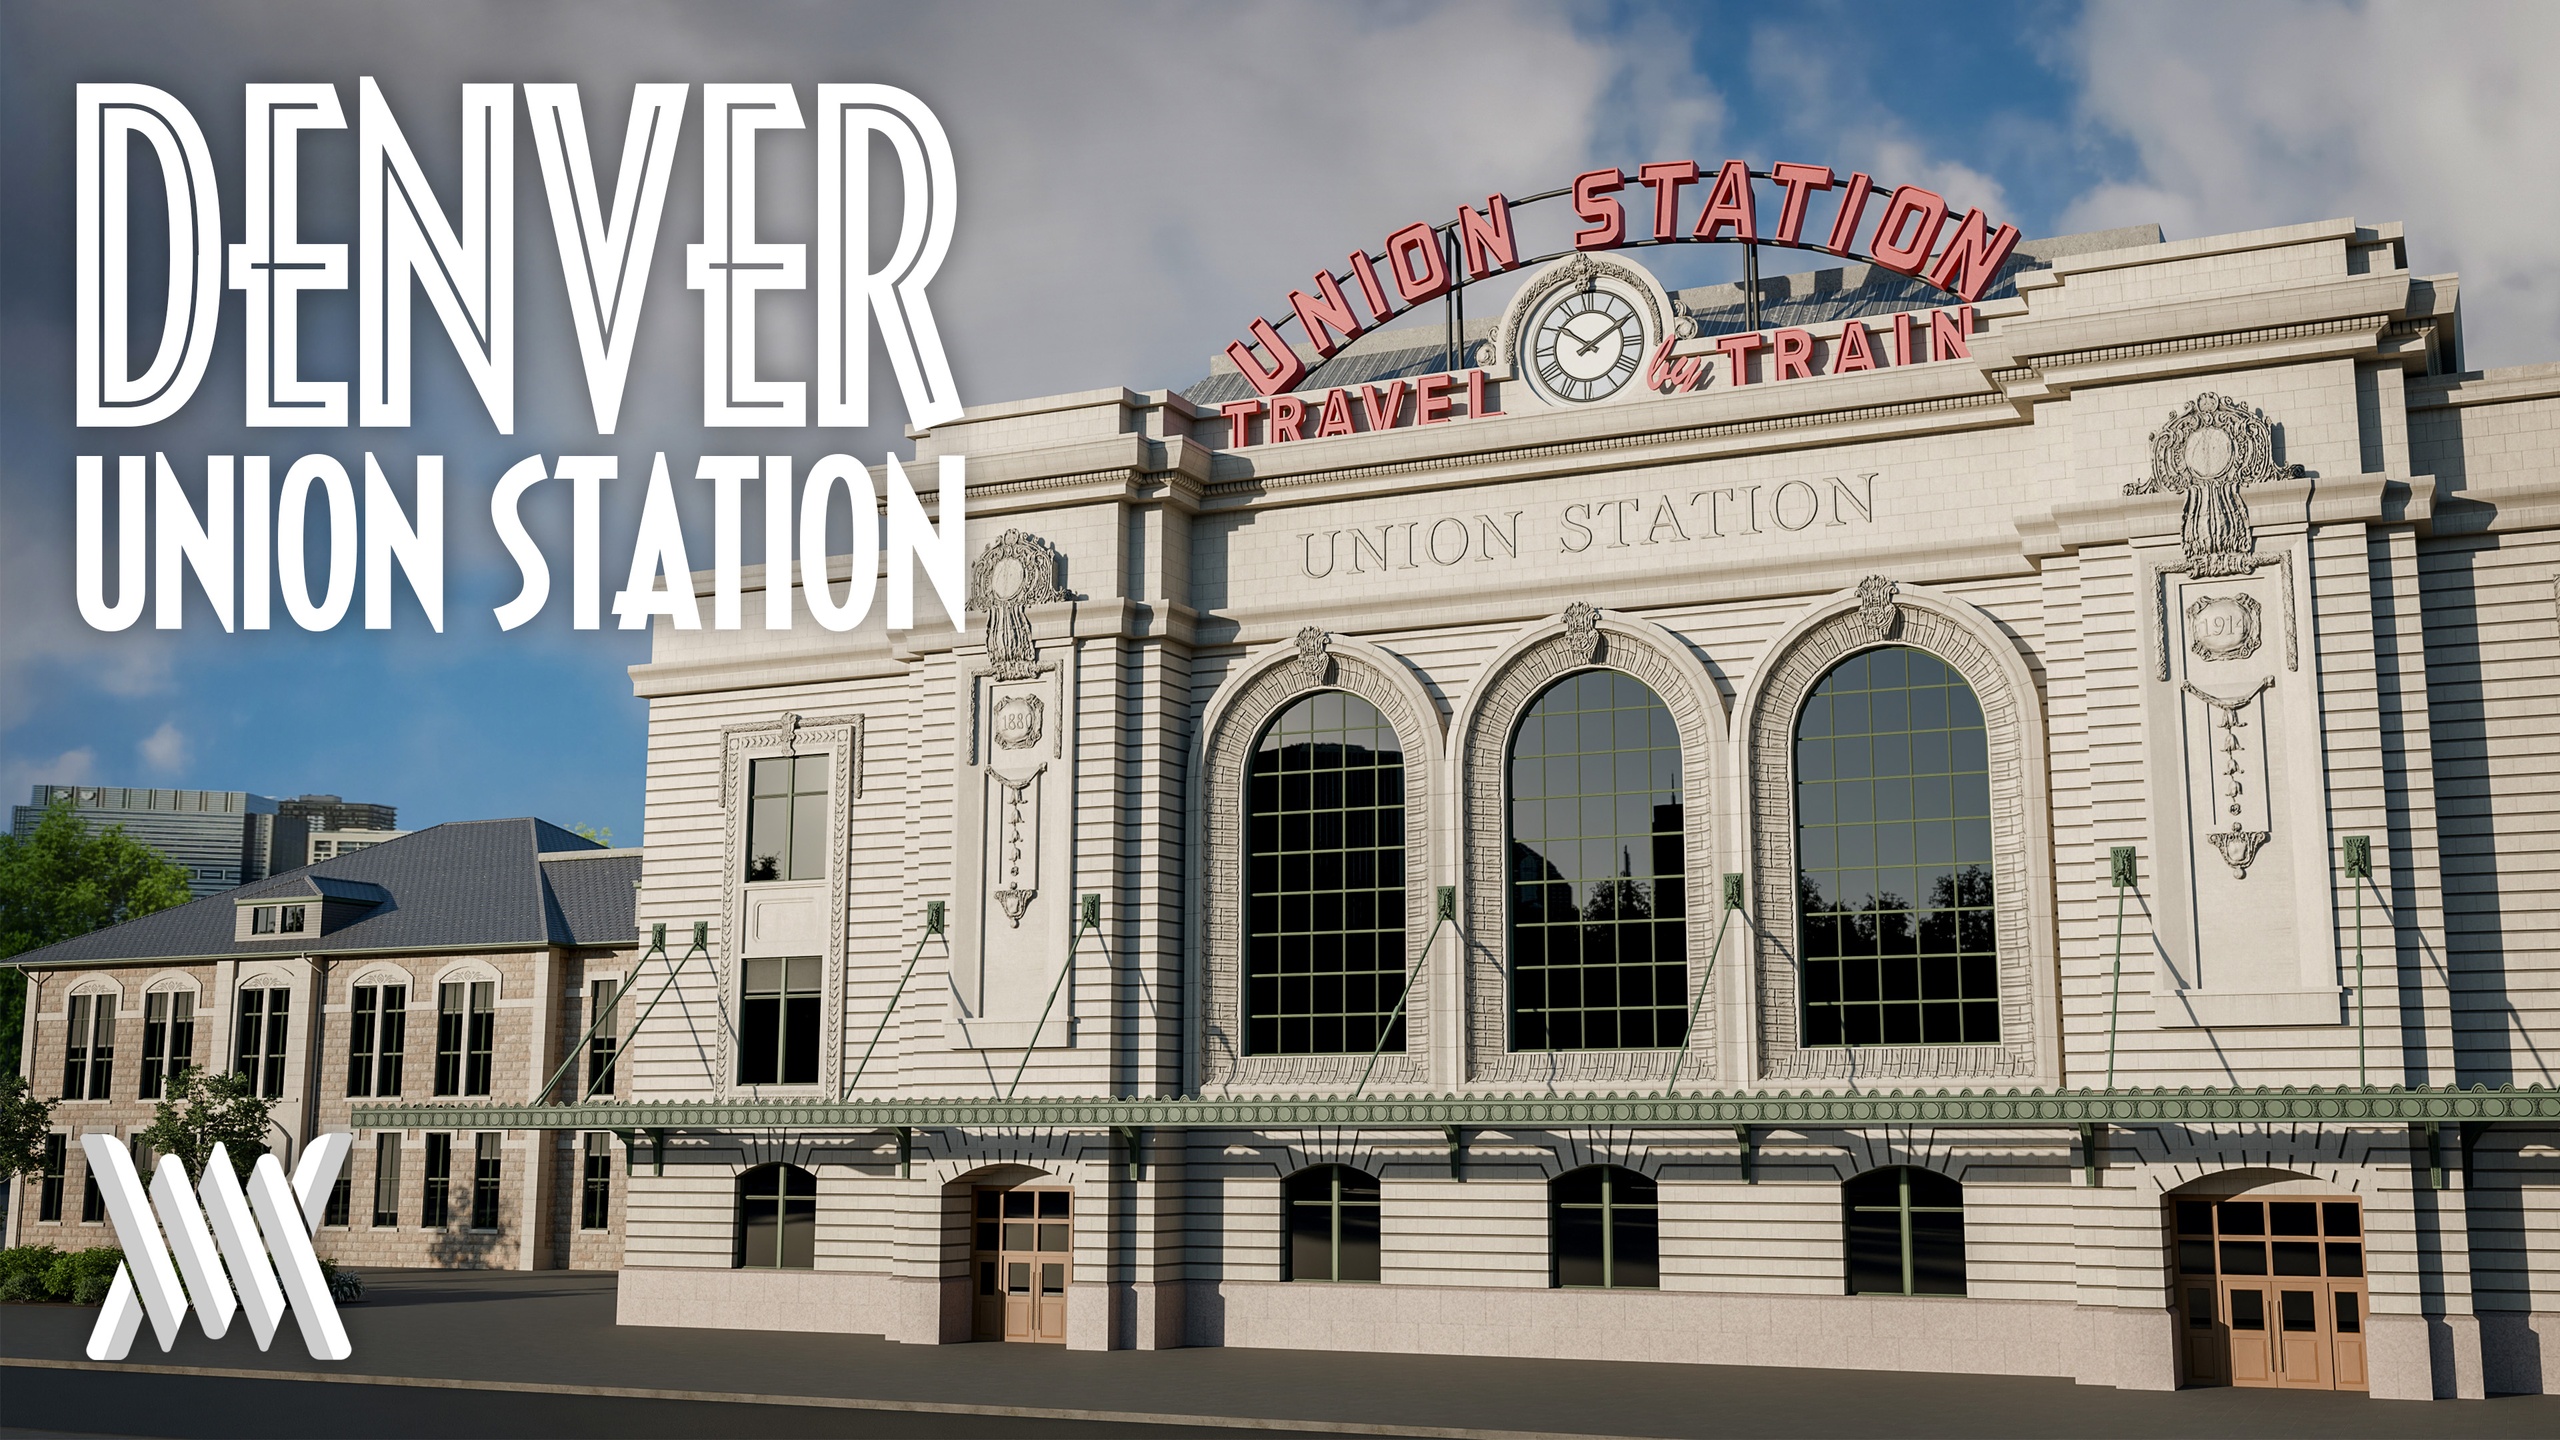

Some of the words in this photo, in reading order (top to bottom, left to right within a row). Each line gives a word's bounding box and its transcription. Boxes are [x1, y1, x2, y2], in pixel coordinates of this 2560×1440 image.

[1224, 192, 1520, 397] UNION
[1572, 159, 2023, 304] STATION
[1220, 369, 1507, 448] TRAVEL
[1647, 333, 1702, 393] by
[1716, 304, 1974, 387] TRAIN
[1296, 511, 1523, 579] UNION
[1560, 473, 1879, 554] STATION
[2200, 615, 2246, 637] 1914
[1002, 712, 1033, 731] 1880
